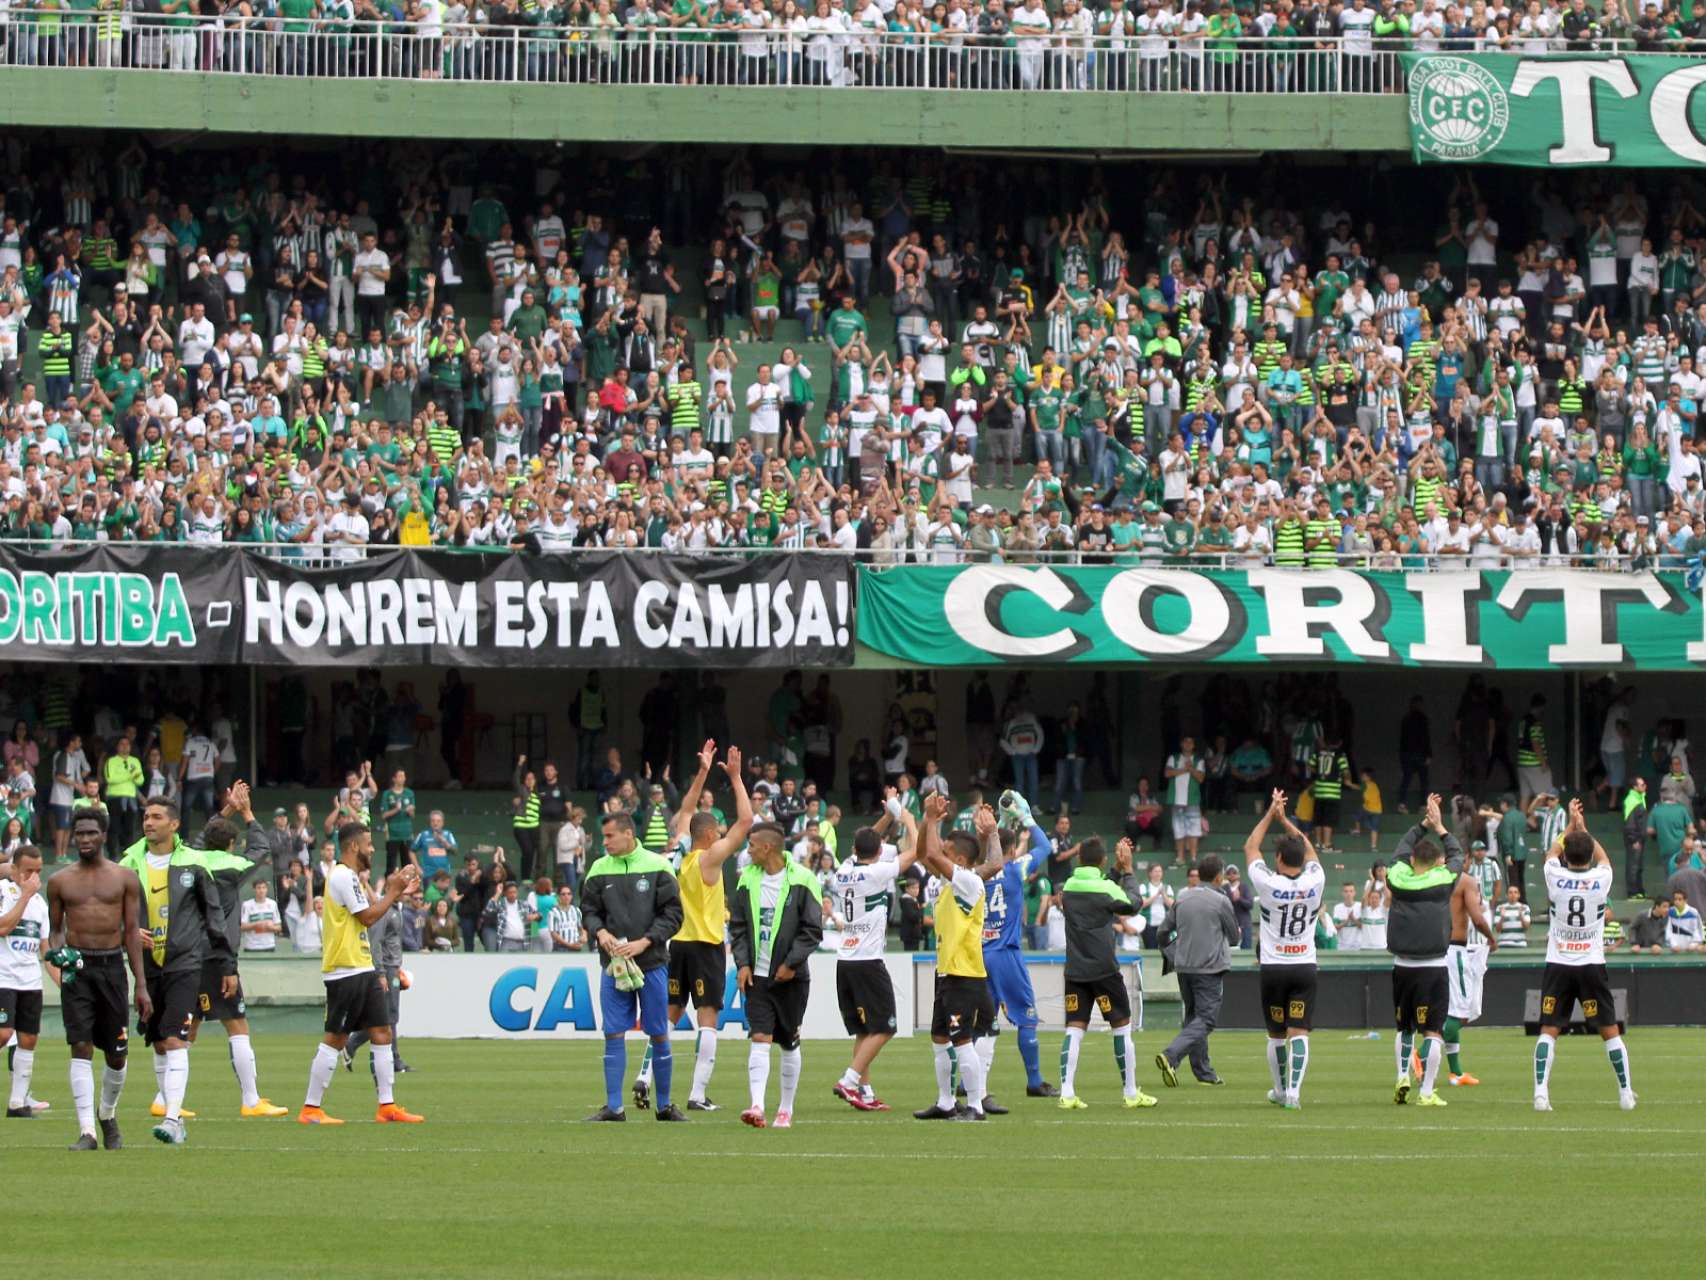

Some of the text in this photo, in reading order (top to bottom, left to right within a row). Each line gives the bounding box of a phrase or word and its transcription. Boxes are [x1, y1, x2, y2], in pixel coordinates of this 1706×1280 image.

[1429, 95, 1485, 123] CFC
[244, 577, 478, 648] HONREM
[494, 580, 621, 649] ESTA
[633, 580, 849, 649] CAMISA!
[943, 566, 1706, 664] CORIT
[1272, 888, 1316, 900] CAIXA
[1556, 879, 1601, 891] CAIXA
[845, 887, 855, 923] 6
[1278, 902, 1308, 938] 18
[1567, 895, 1586, 928] 8
[1284, 944, 1308, 954] RDP
